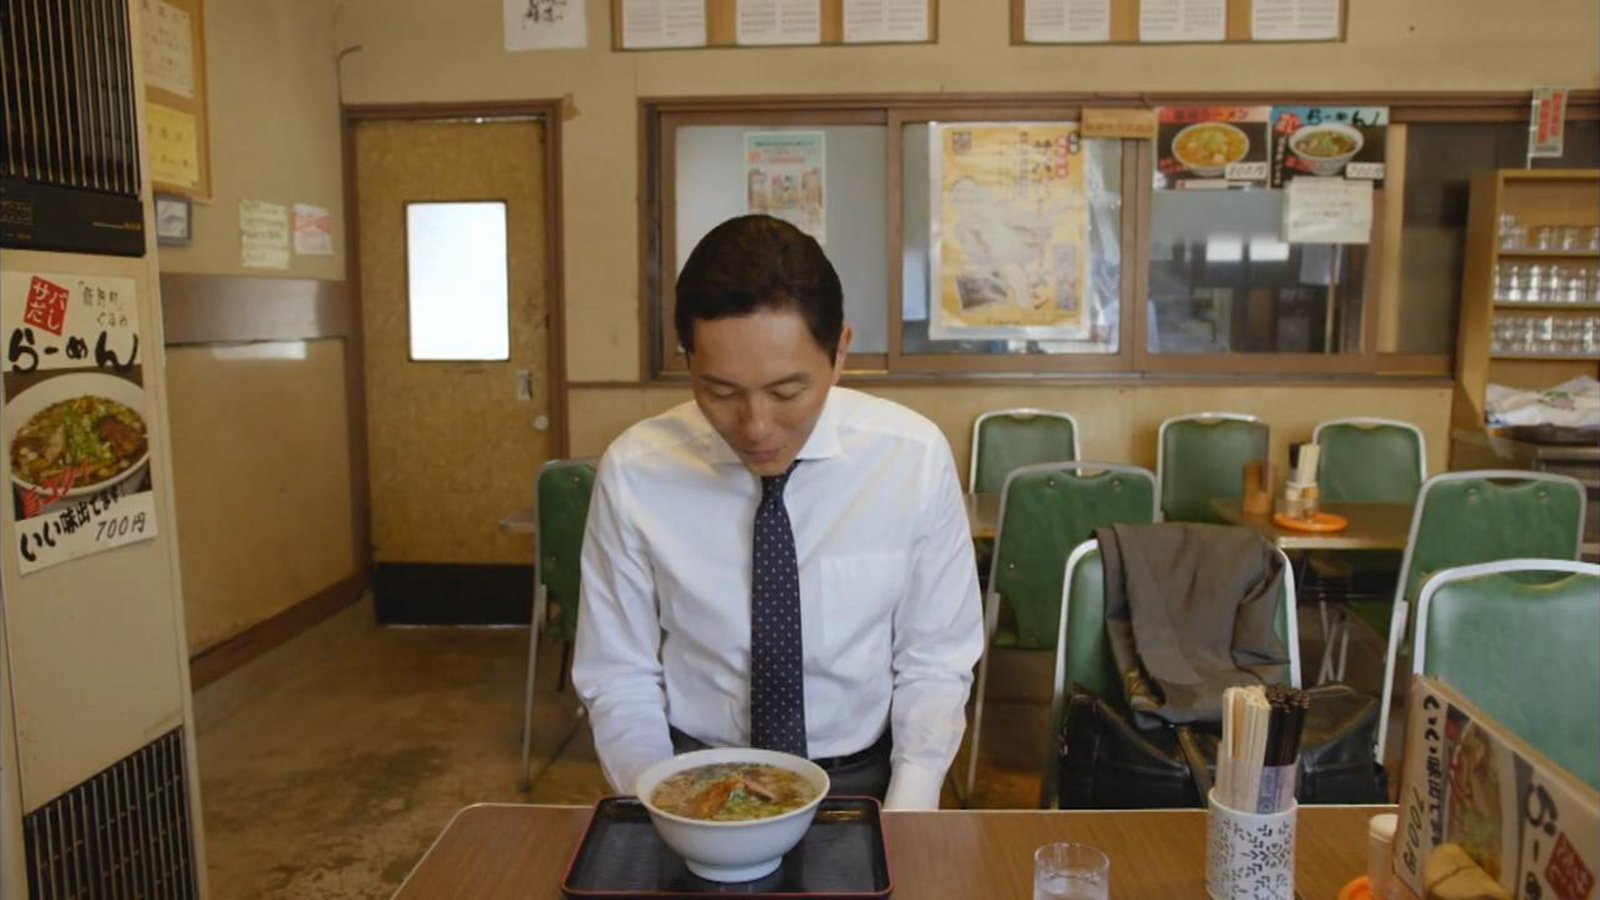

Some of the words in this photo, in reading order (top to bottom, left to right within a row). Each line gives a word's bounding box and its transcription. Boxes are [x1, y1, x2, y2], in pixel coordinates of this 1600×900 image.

[33, 281, 69, 312] サバ
[26, 301, 62, 332] だし
[8, 327, 139, 374] らーめん
[95, 511, 146, 541] 700円
[1403, 787, 1425, 876] 700円
